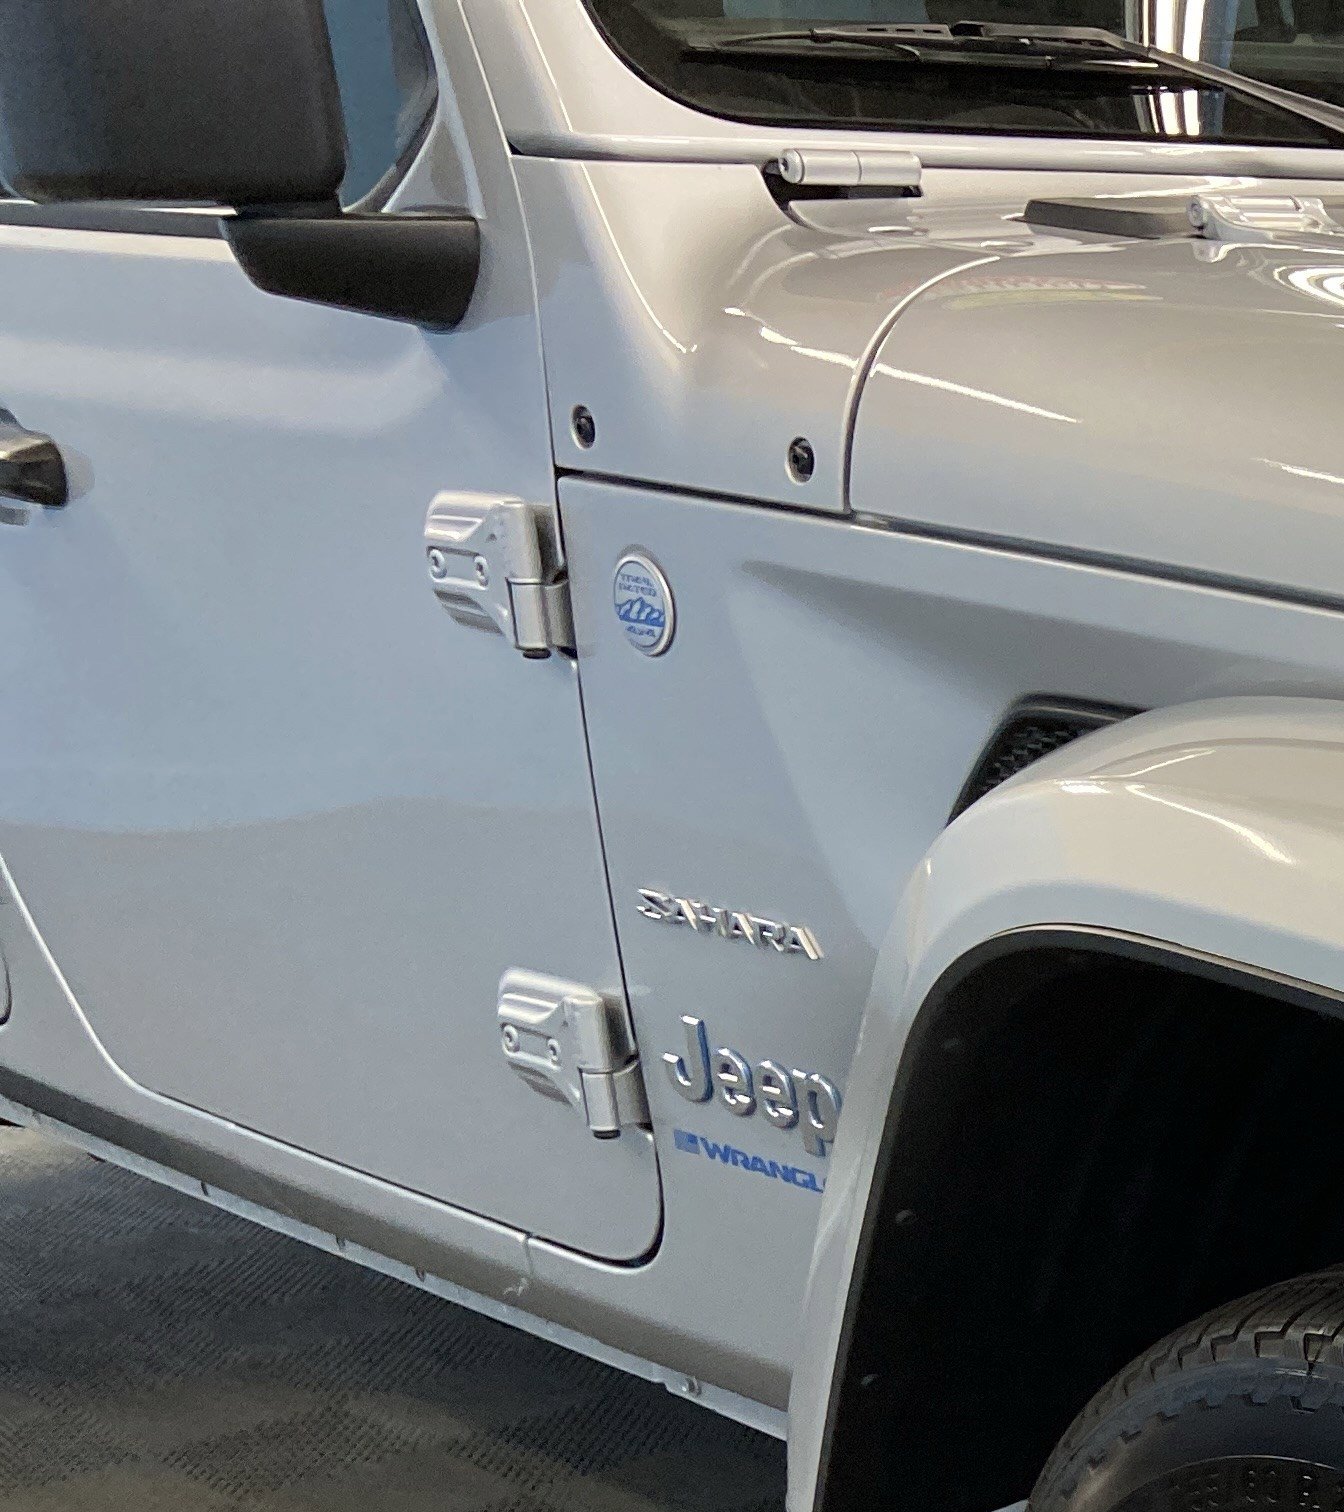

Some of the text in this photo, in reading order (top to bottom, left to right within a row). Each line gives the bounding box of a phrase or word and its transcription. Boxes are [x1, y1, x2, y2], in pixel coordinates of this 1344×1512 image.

[637, 888, 824, 960] SAHARA
[663, 1015, 842, 1157] Jeep
[700, 1136, 825, 1194] WRANGL
